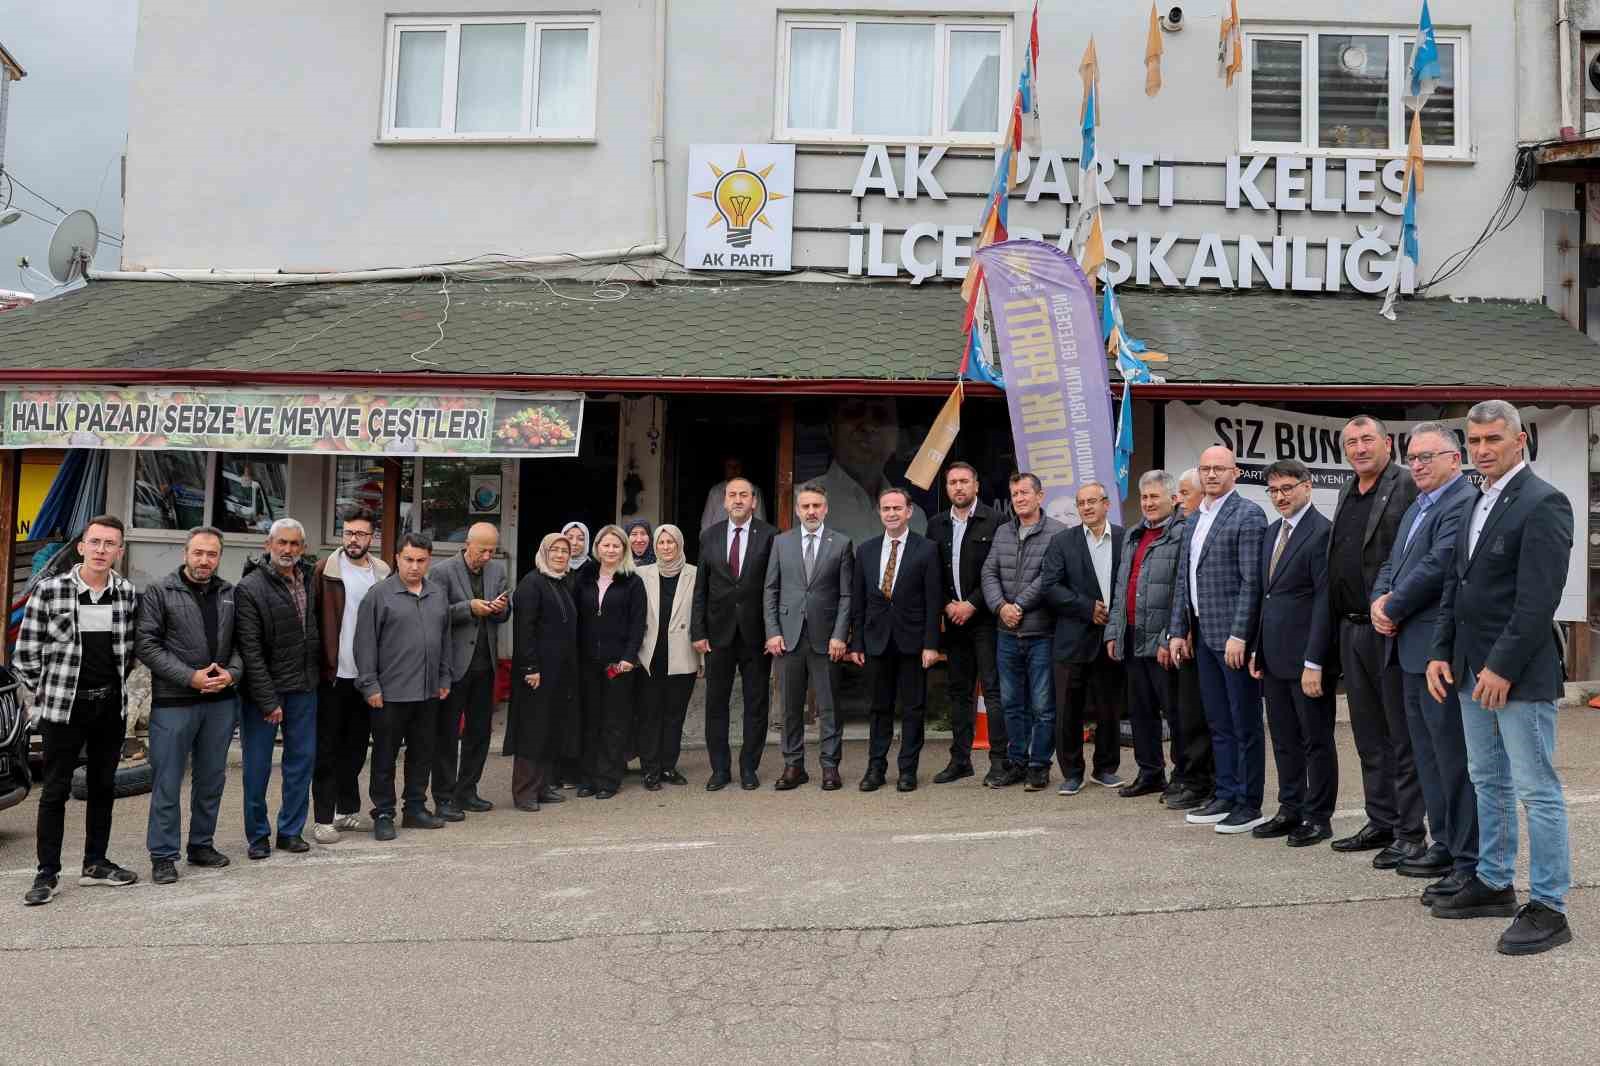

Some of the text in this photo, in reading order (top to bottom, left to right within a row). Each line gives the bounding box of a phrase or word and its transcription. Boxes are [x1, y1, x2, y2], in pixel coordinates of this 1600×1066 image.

[851, 145, 949, 201] AK
[702, 254, 773, 267] AK PARTİ
[848, 222, 974, 285] İLÇE
[12, 402, 488, 442] HALK PAZARI SEBZE VE MEYVE ÇEŞİTLERİ
[1214, 416, 1266, 459] SİZ
[1275, 422, 1342, 464] BUN
